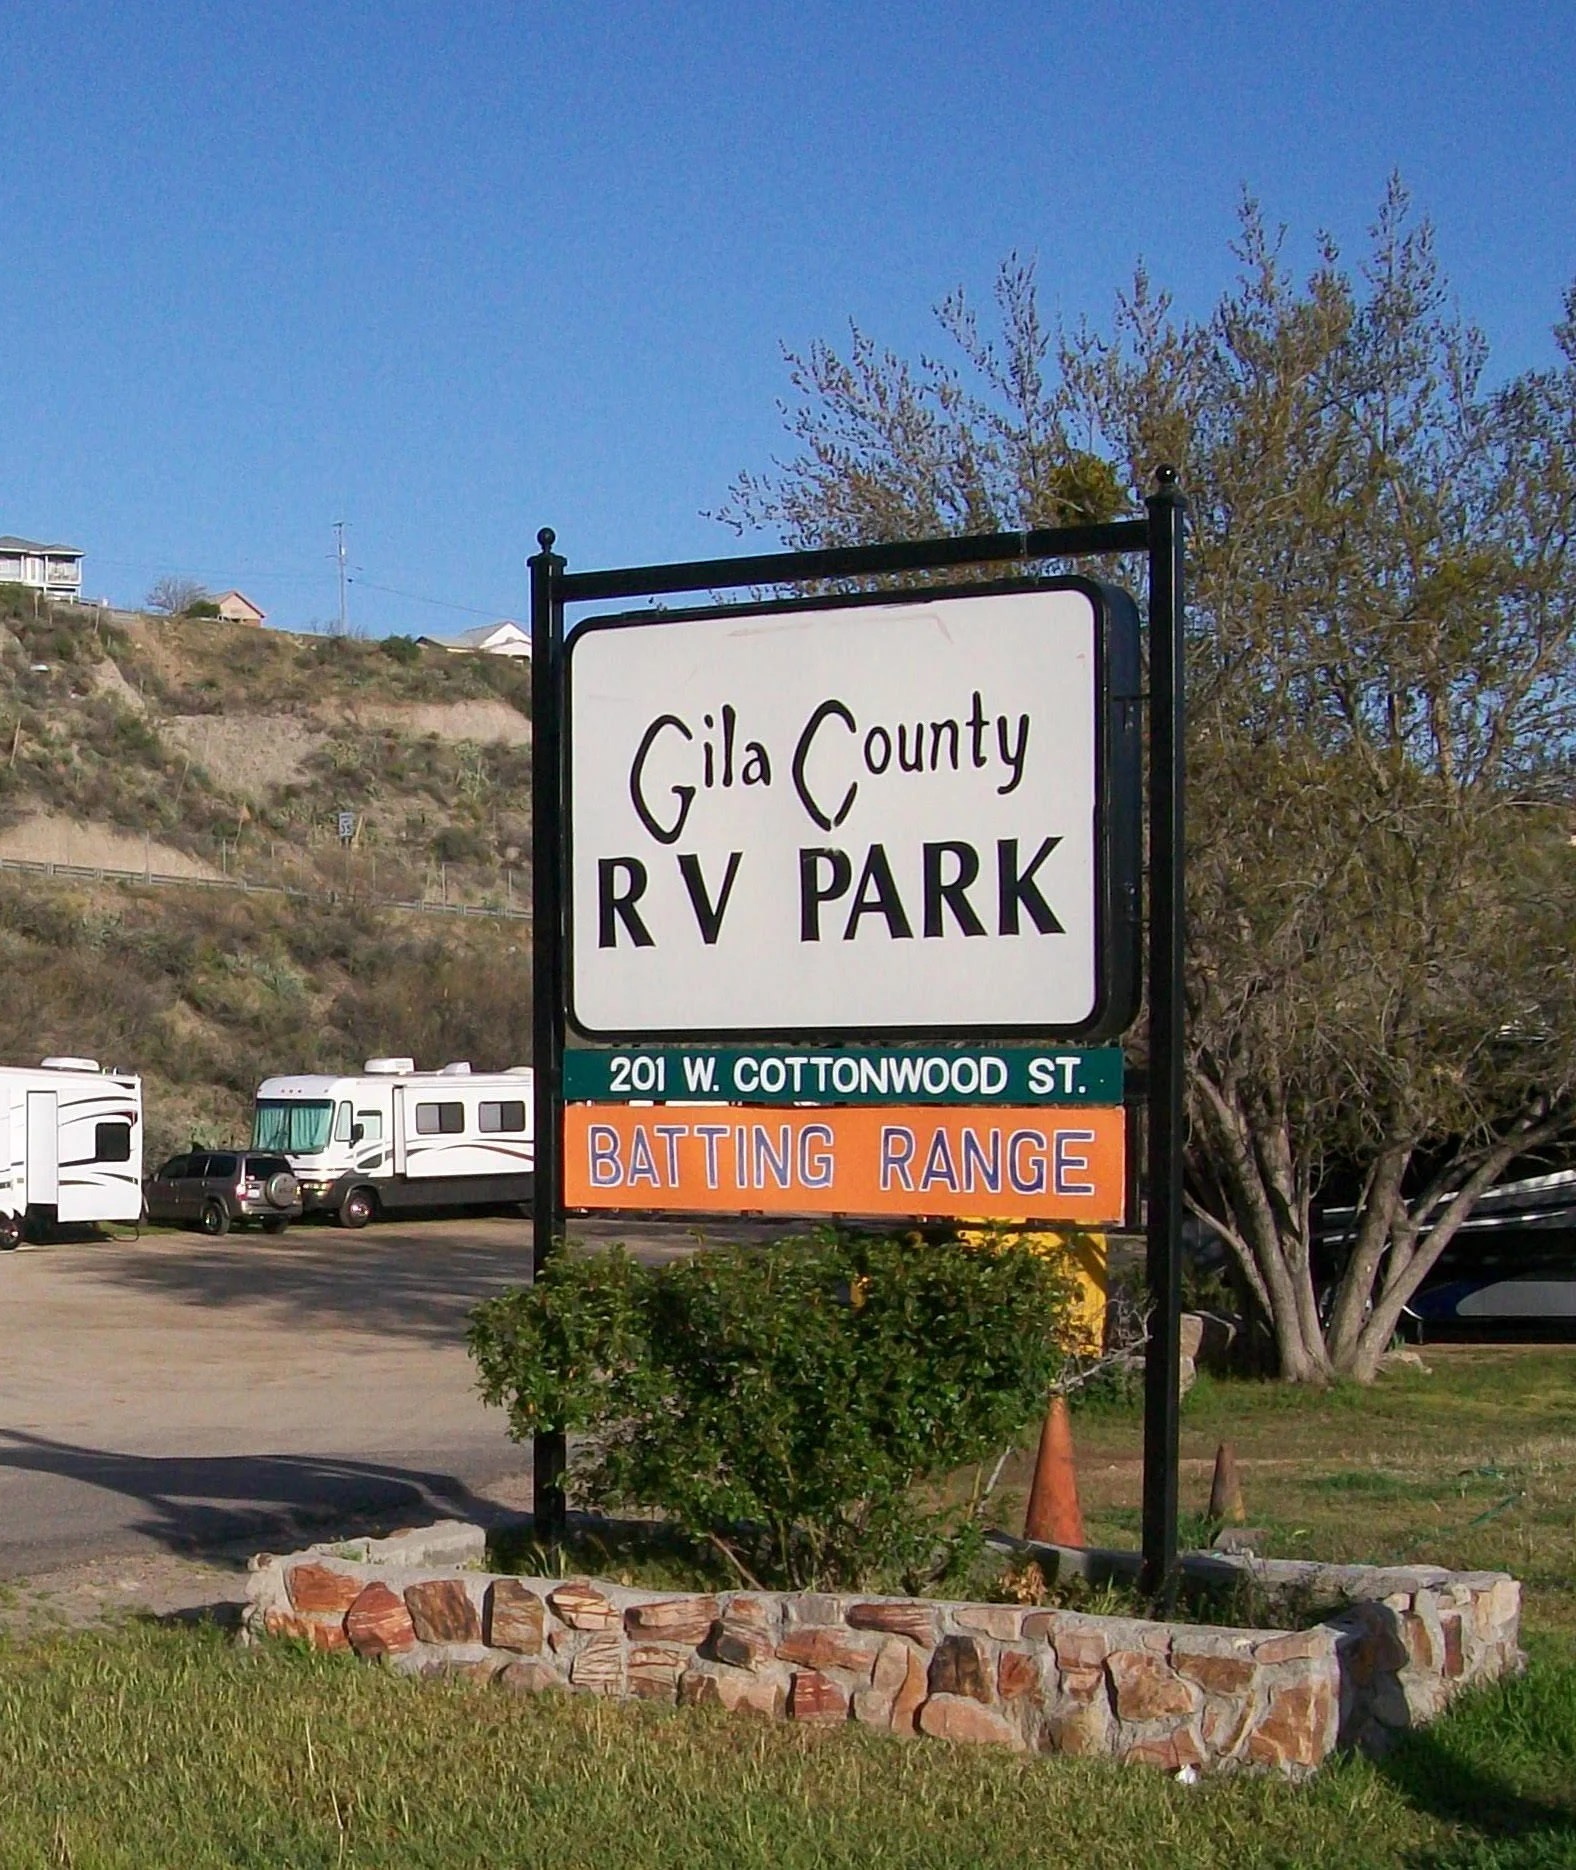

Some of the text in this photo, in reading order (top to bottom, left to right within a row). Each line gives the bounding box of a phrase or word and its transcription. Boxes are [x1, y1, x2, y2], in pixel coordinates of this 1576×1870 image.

[630, 690, 1031, 845] Gila County
[598, 836, 1066, 949] RV PARK
[610, 1056, 1086, 1094] 201 W. COTTONWOOD ST.
[587, 1123, 1097, 1197] BATTING RANGE
